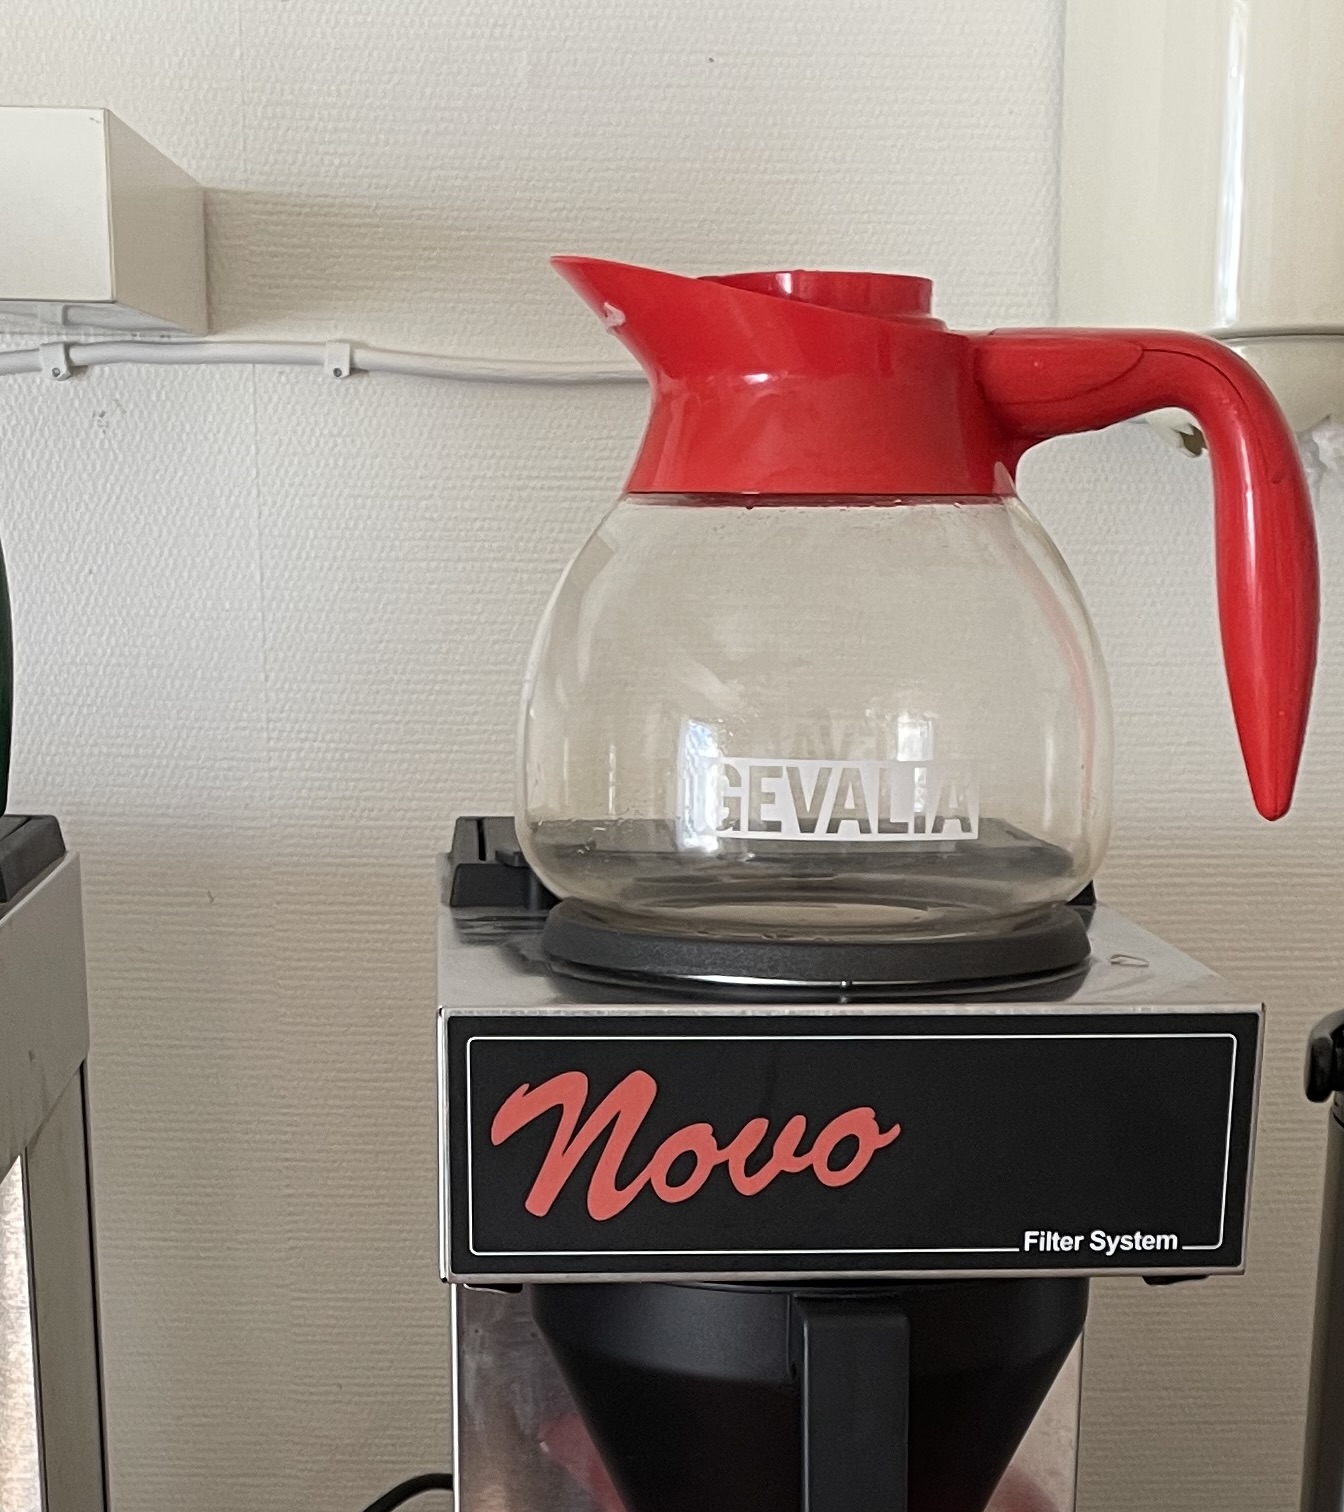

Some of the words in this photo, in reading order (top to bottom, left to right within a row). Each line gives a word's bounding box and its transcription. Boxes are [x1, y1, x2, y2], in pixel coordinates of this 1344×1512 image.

[490, 1070, 900, 1221] Novo
[1023, 1231, 1084, 1252] Filter
[1089, 1230, 1179, 1256] System
